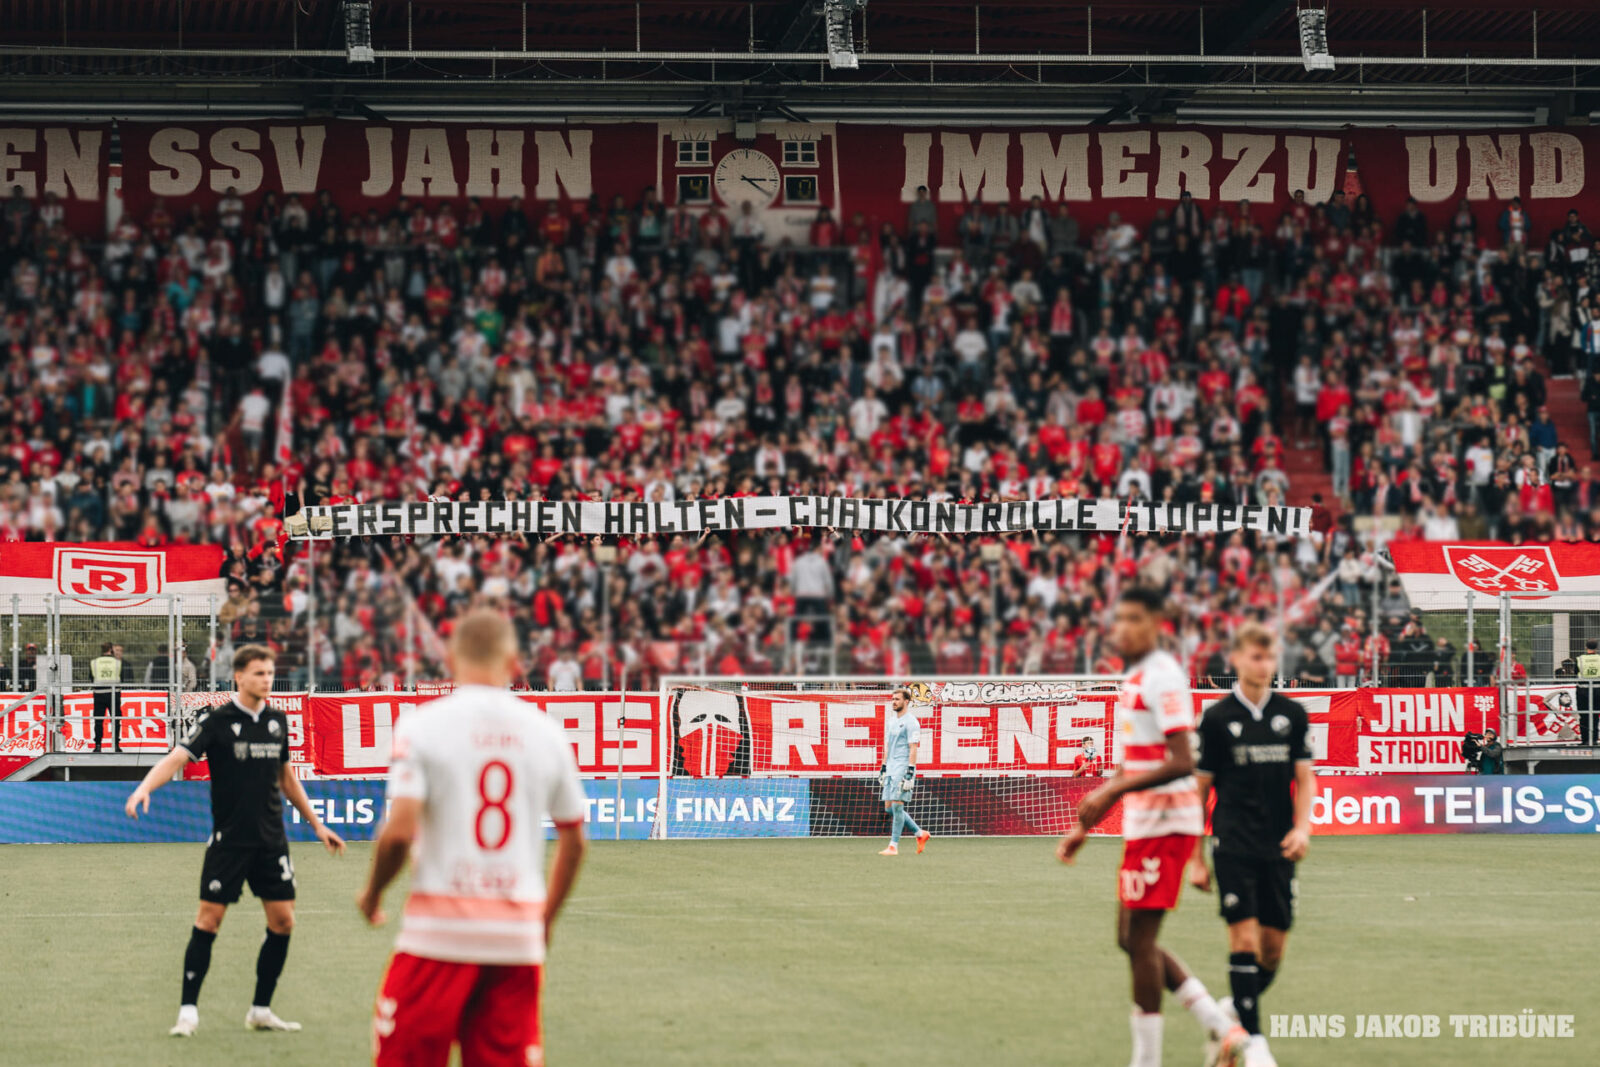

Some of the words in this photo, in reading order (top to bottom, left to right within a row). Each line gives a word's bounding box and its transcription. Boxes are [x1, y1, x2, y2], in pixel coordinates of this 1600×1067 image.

[149, 125, 326, 196] SSV
[361, 126, 594, 200] JAHN
[901, 131, 1341, 205] IMMERZU
[1405, 132, 1586, 202] UND
[604, 498, 746, 533] HALTEN
[789, 497, 1097, 532] CHATKONTROLLE
[1118, 499, 1301, 536] STOPPEN!
[942, 682, 980, 702] RED
[1370, 694, 1465, 733] JAHN
[1369, 740, 1466, 764] STADION
[475, 760, 514, 851] 8
[676, 797, 796, 822] FINANZ
[1308, 787, 1401, 825] dem
